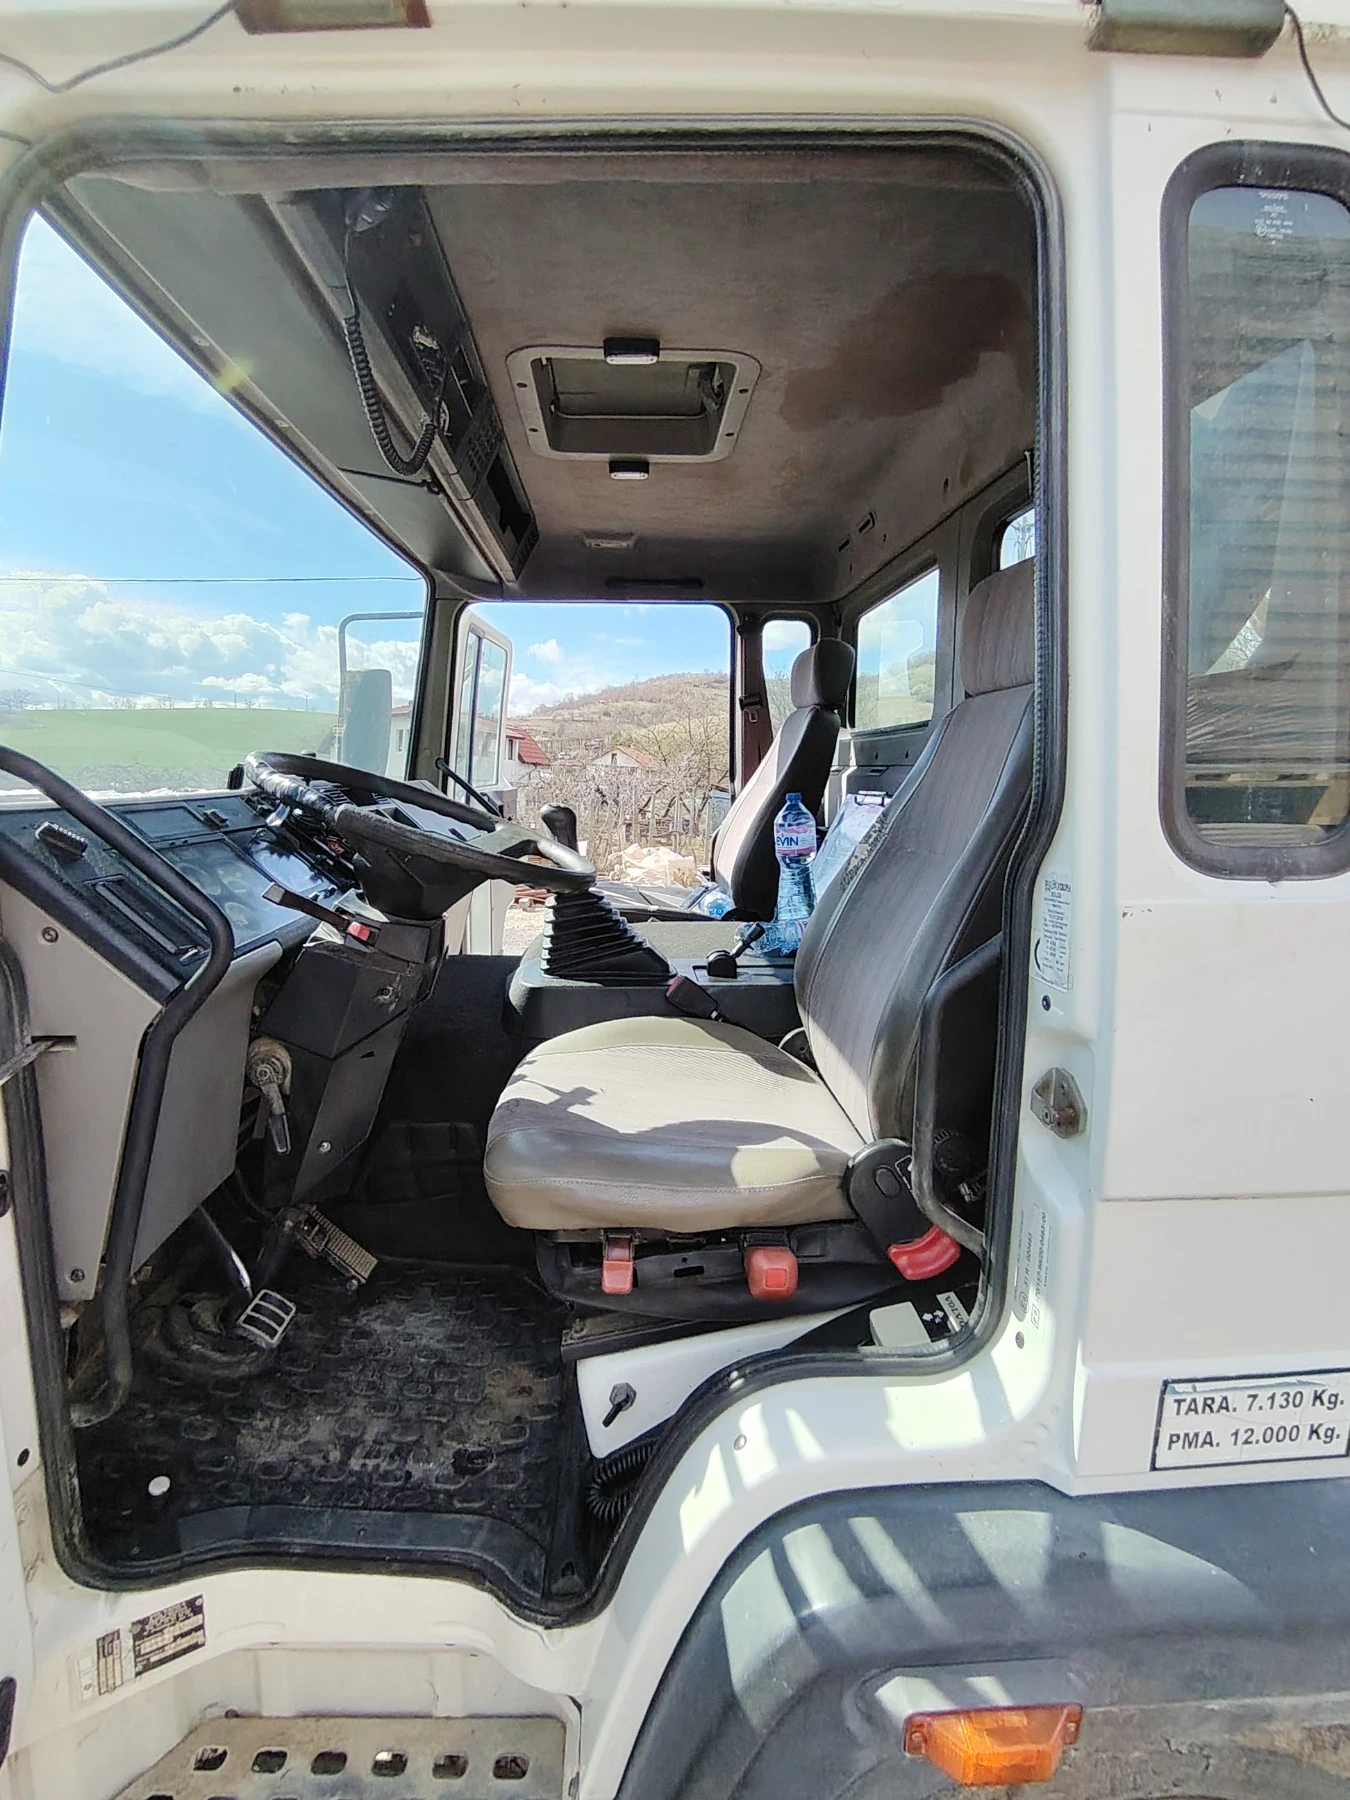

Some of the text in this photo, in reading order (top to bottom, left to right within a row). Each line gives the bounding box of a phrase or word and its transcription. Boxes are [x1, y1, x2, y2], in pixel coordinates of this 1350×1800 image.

[1173, 1388, 1345, 1416] TARA. 7.130 Kg.
[1167, 1423, 1341, 1450] PMA. 12.000 Kg.
